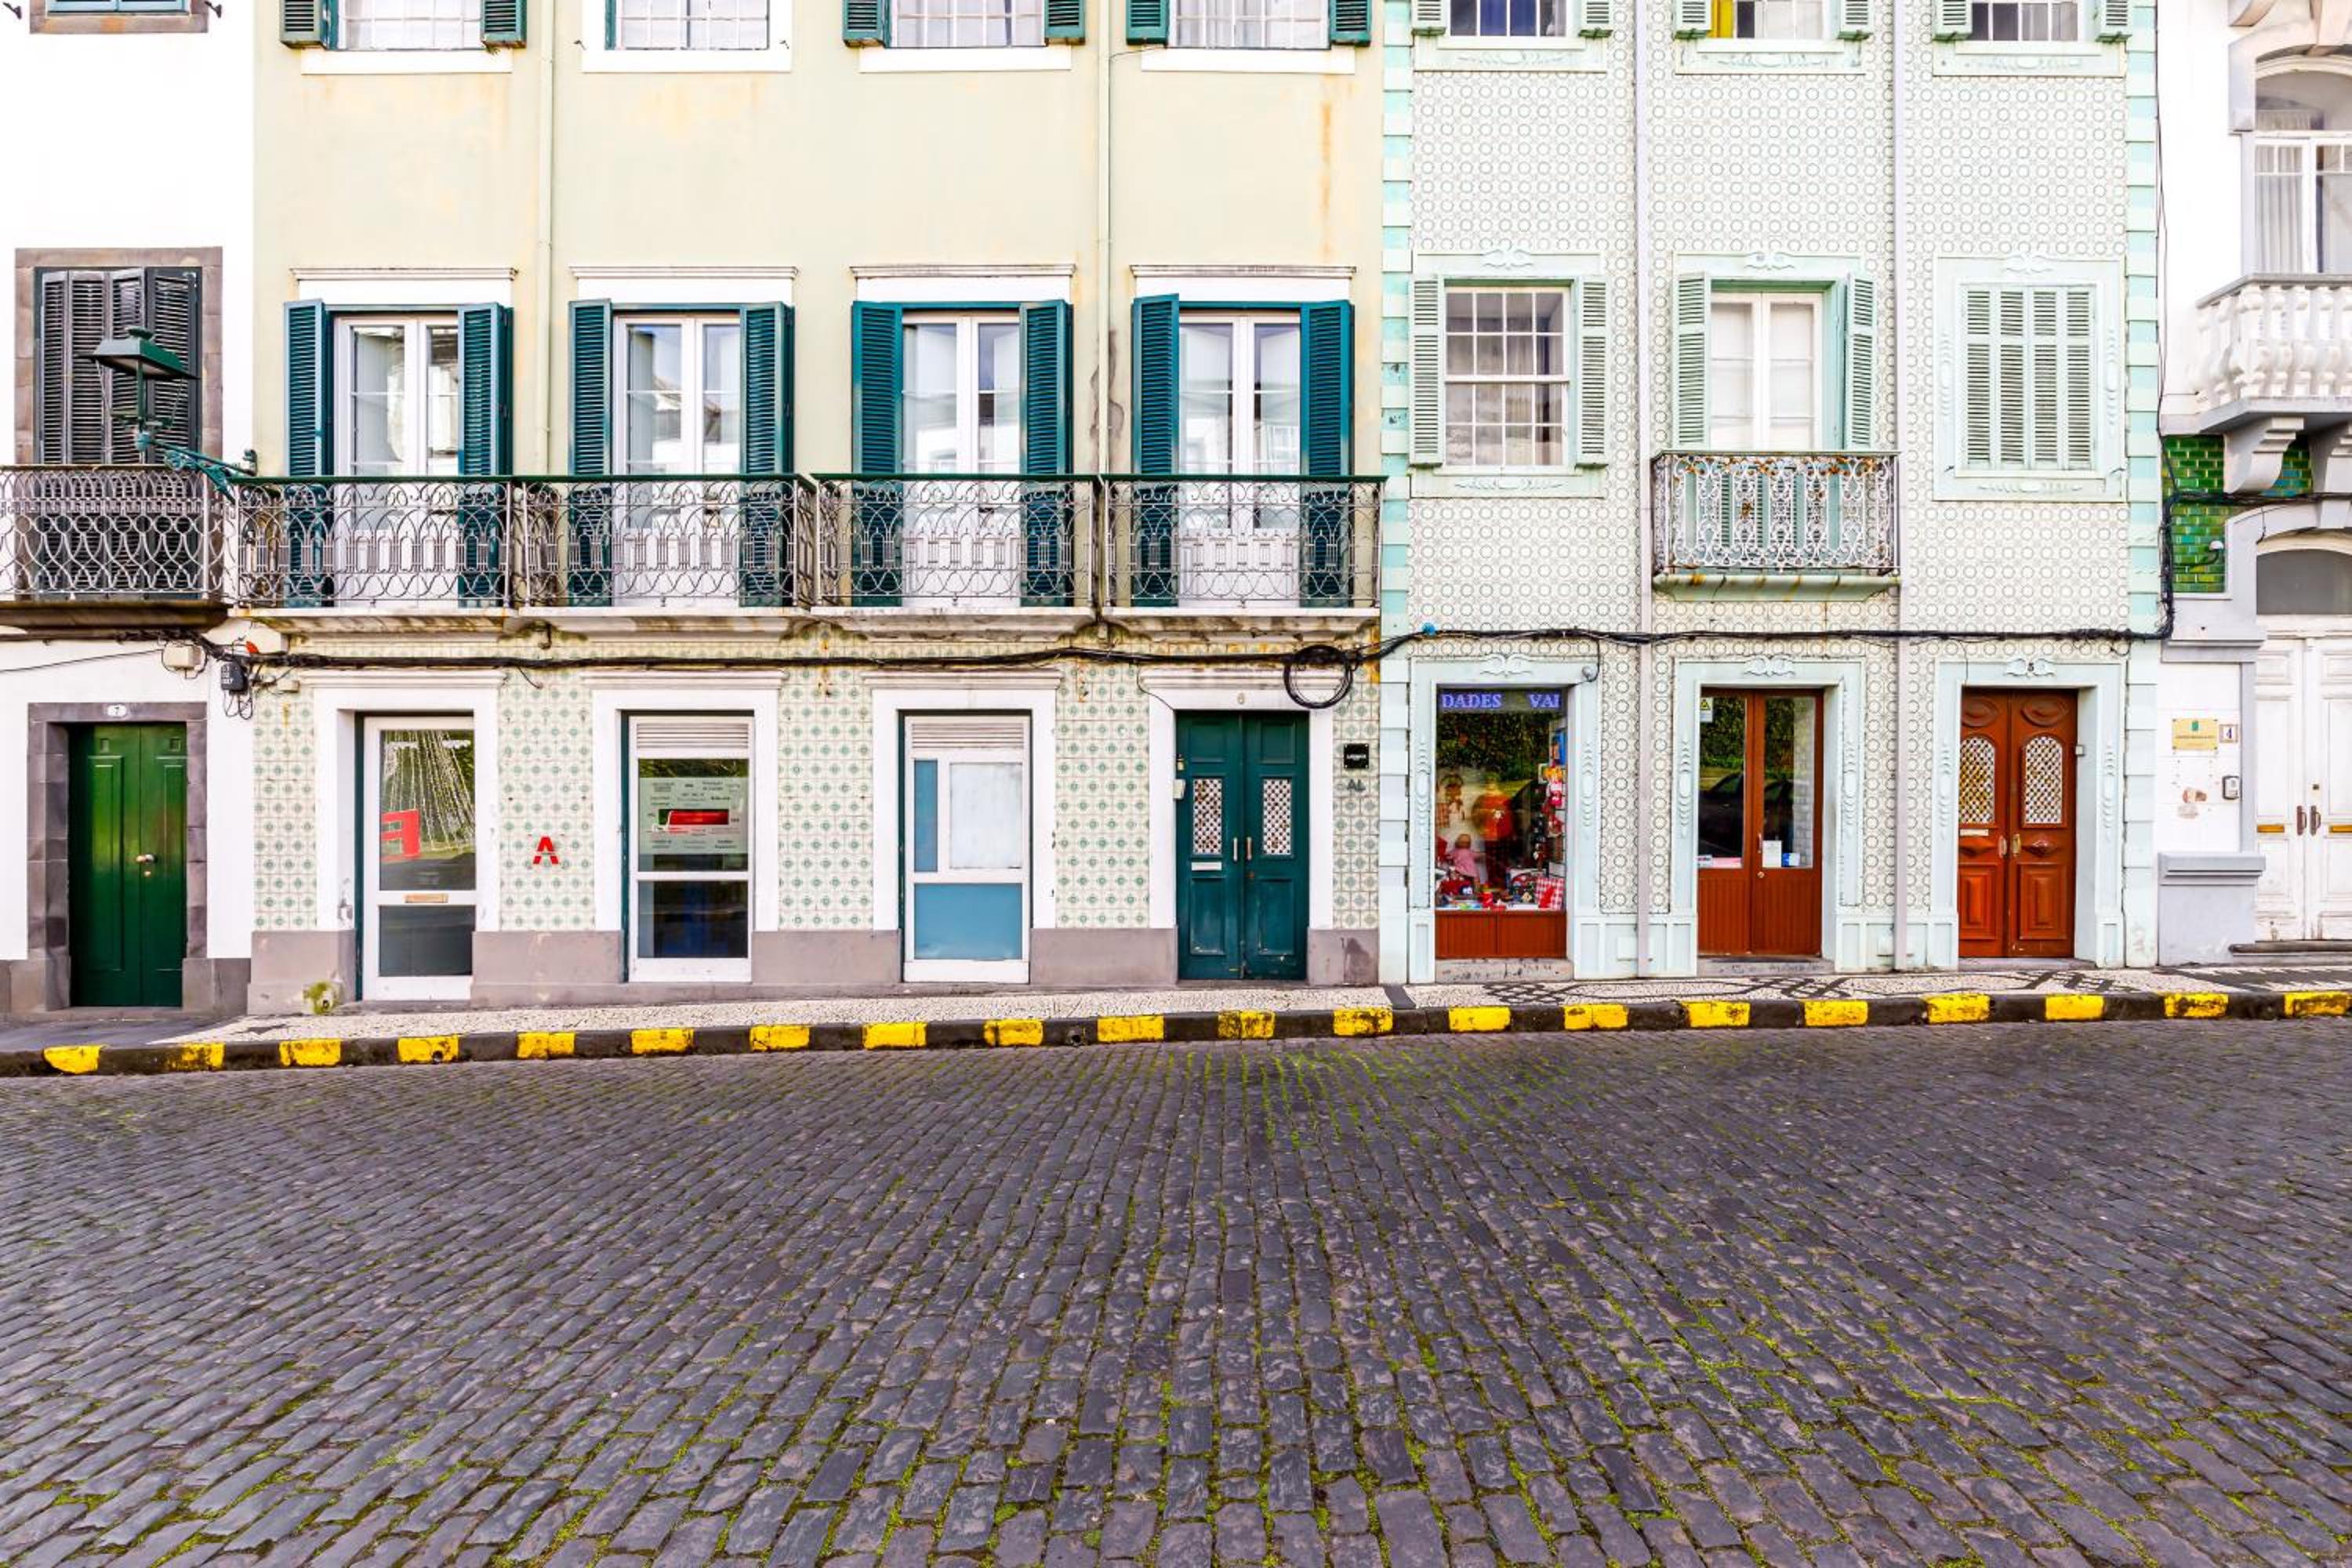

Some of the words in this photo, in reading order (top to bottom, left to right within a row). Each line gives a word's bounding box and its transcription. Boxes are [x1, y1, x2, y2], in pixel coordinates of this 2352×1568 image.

[1442, 693, 1501, 708] DADES
[1530, 693, 1560, 708] VAI
[2227, 727, 2233, 739] 4
